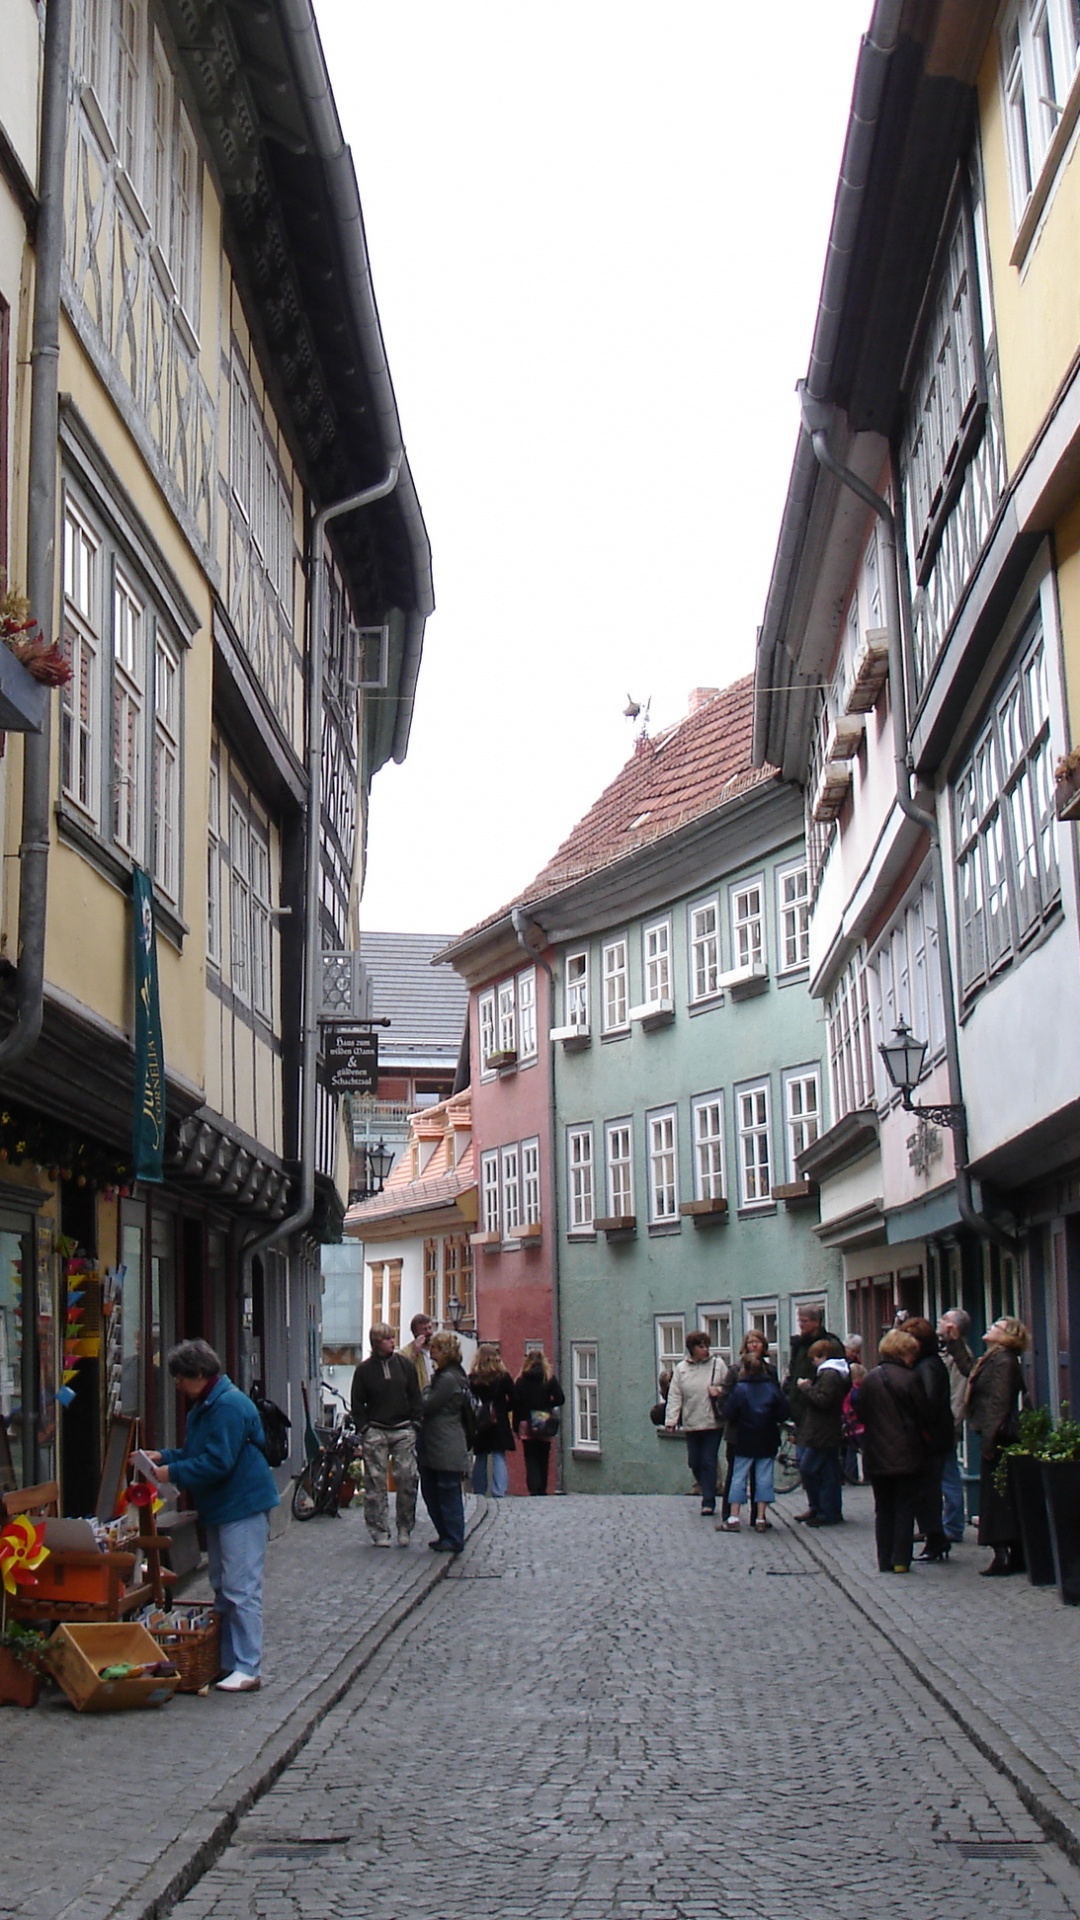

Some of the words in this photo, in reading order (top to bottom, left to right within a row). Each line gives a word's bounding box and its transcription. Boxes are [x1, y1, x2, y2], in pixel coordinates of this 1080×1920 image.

[353, 1047, 374, 1055] Mann
[347, 1055, 357, 1068] &
[147, 1040, 162, 1124] CORNELIA
